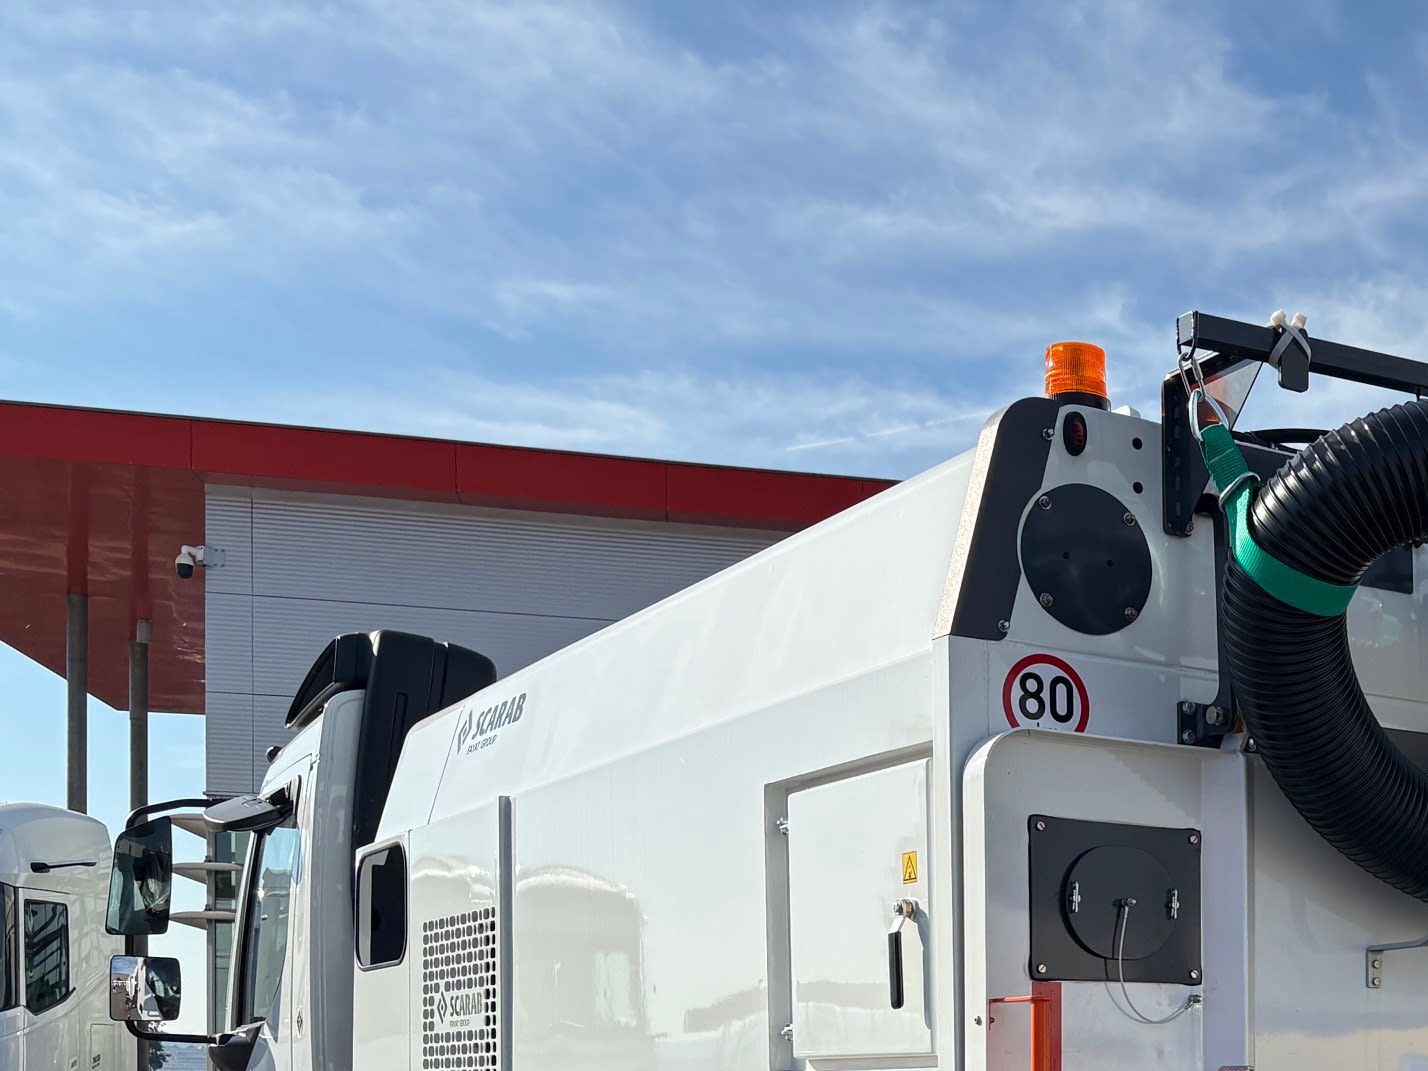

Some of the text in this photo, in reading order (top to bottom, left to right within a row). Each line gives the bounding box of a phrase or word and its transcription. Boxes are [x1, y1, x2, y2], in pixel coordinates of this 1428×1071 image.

[472, 692, 527, 740] SCARAB
[1018, 671, 1075, 724] 80
[450, 992, 483, 1017] SCARAB
